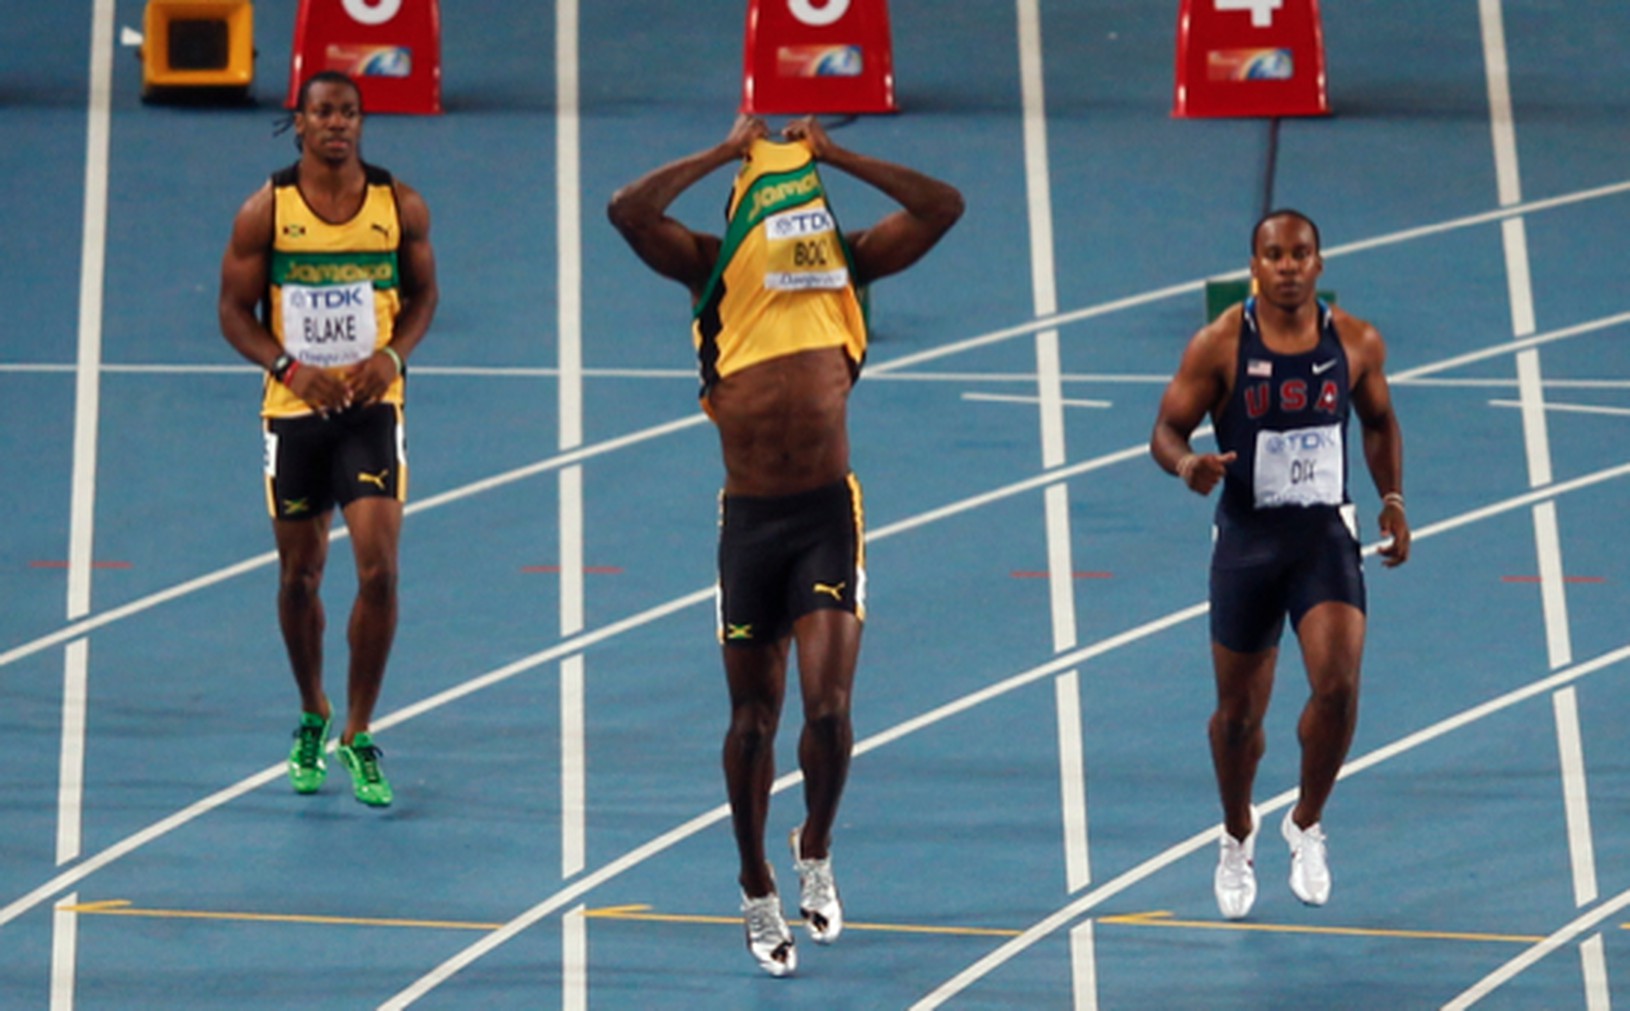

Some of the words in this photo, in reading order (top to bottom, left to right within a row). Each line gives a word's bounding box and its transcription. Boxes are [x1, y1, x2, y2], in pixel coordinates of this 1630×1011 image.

[791, 212, 830, 231] TD
[308, 287, 363, 309] TDK
[303, 315, 356, 343] BLAKE
[1244, 380, 1338, 418] USA
[1288, 431, 1335, 450] TDK
